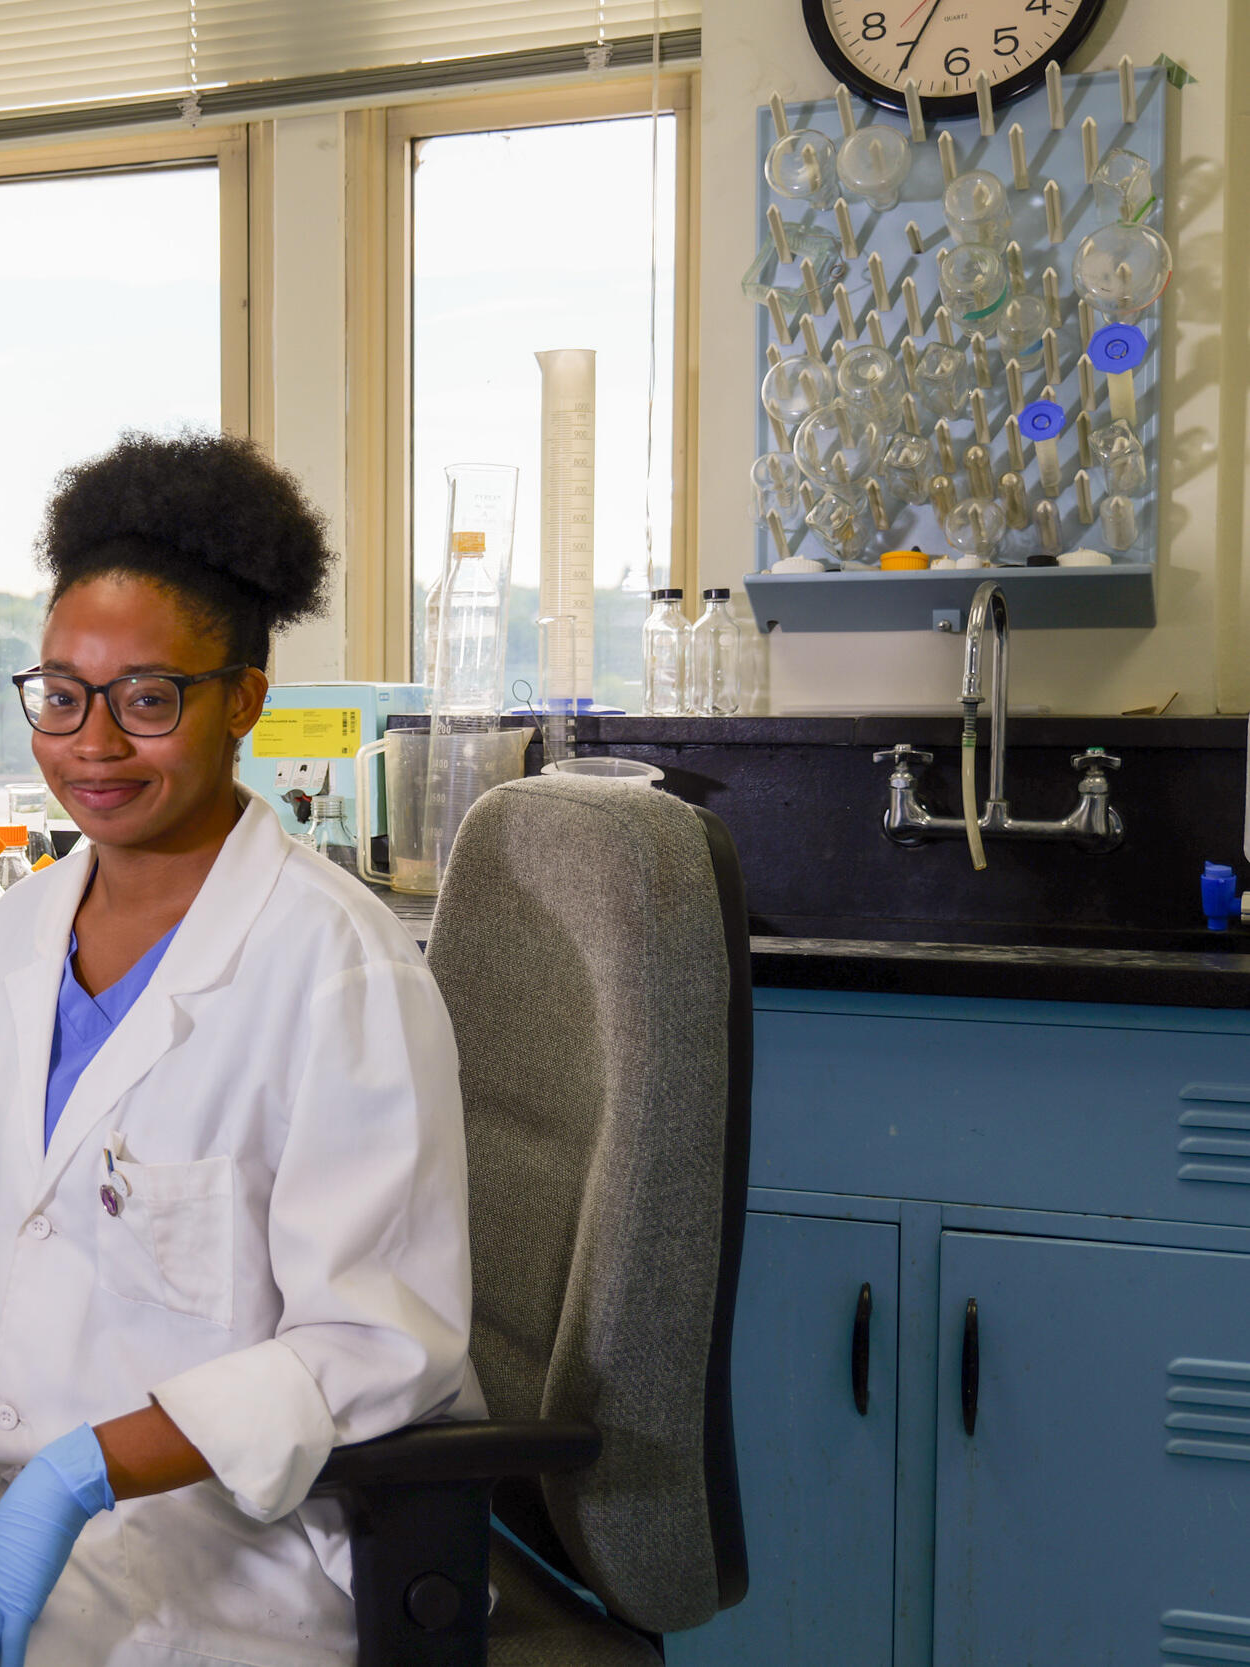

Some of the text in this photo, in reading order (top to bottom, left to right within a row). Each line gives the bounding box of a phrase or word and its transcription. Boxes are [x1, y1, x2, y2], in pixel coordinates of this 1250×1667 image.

[862, 12, 887, 41] 8
[944, 13, 968, 22] QUARTZ
[896, 41, 919, 70] 7
[992, 26, 1019, 56] 5
[944, 47, 970, 76] 6
